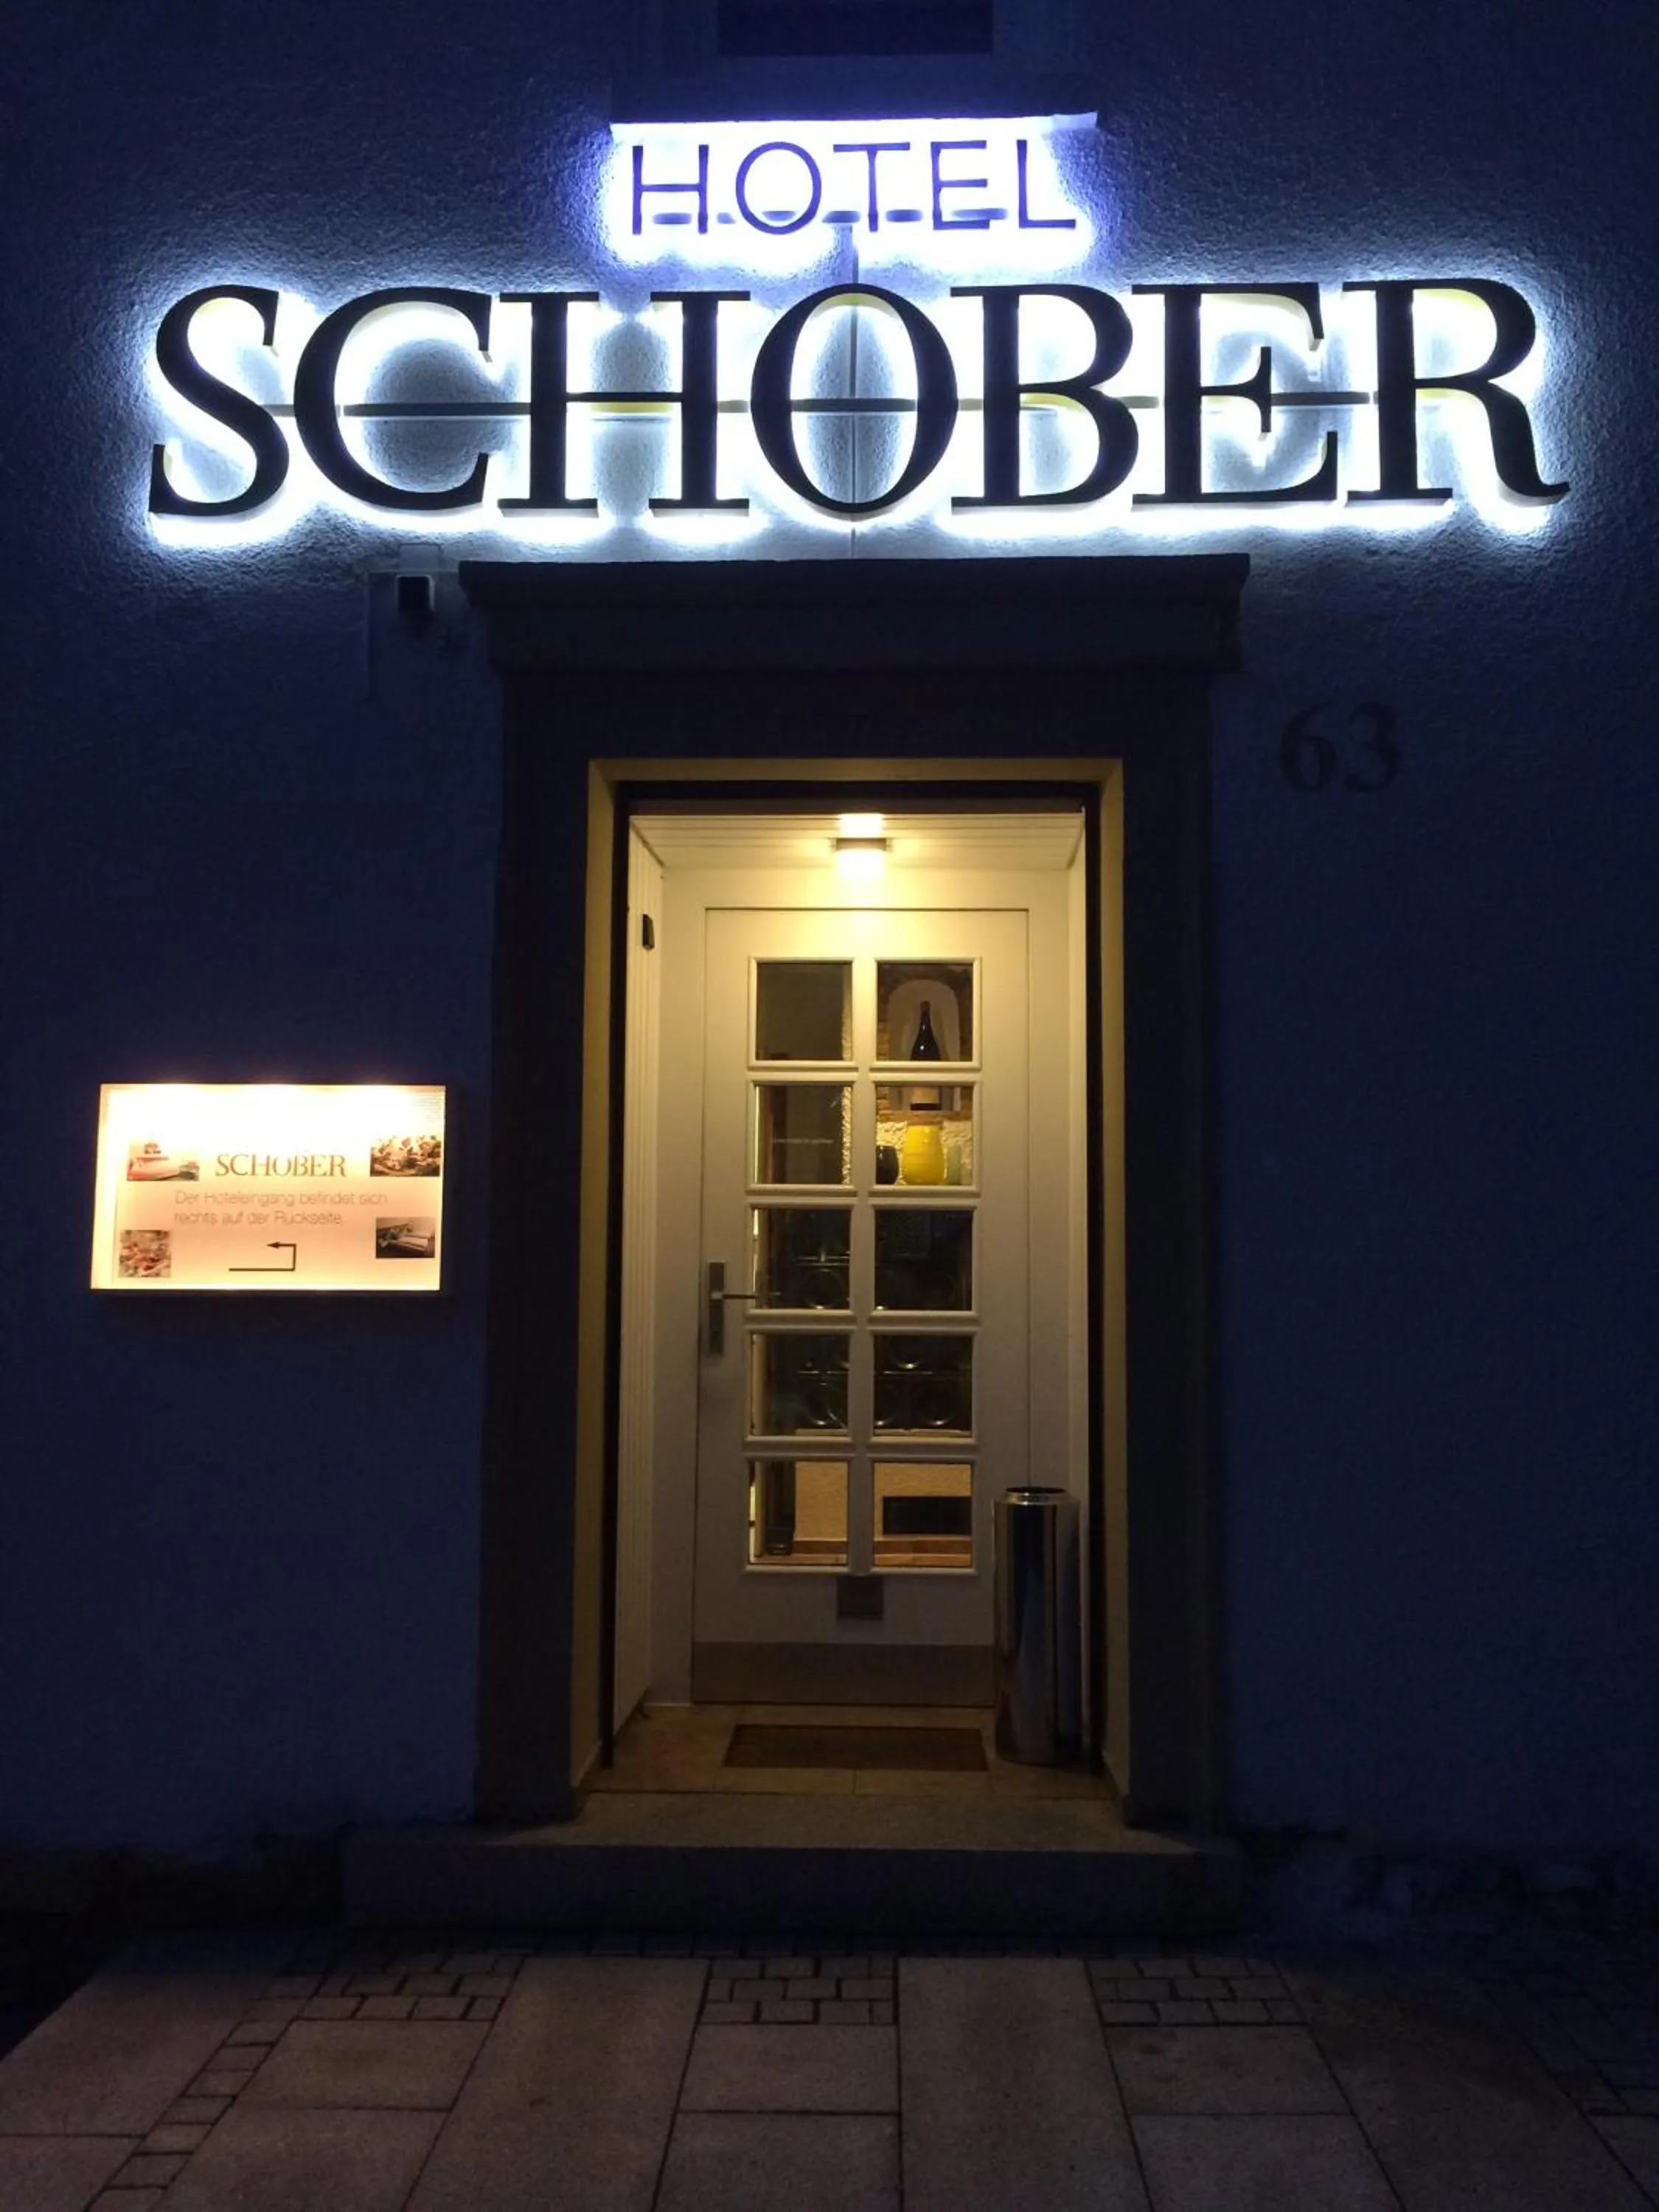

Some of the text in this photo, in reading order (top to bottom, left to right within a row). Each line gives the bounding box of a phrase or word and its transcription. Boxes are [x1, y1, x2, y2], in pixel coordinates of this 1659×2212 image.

[633, 139, 1076, 235] HOTEL
[149, 278, 1571, 516] SCHOBER
[1279, 701, 1401, 793] 63
[215, 1153, 347, 1178] SCHOBER
[174, 1210, 218, 1225] rechts
[222, 1210, 243, 1225] auf
[247, 1210, 270, 1225] der
[175, 1190, 388, 1207] Der Hoteleingang befindet sich
